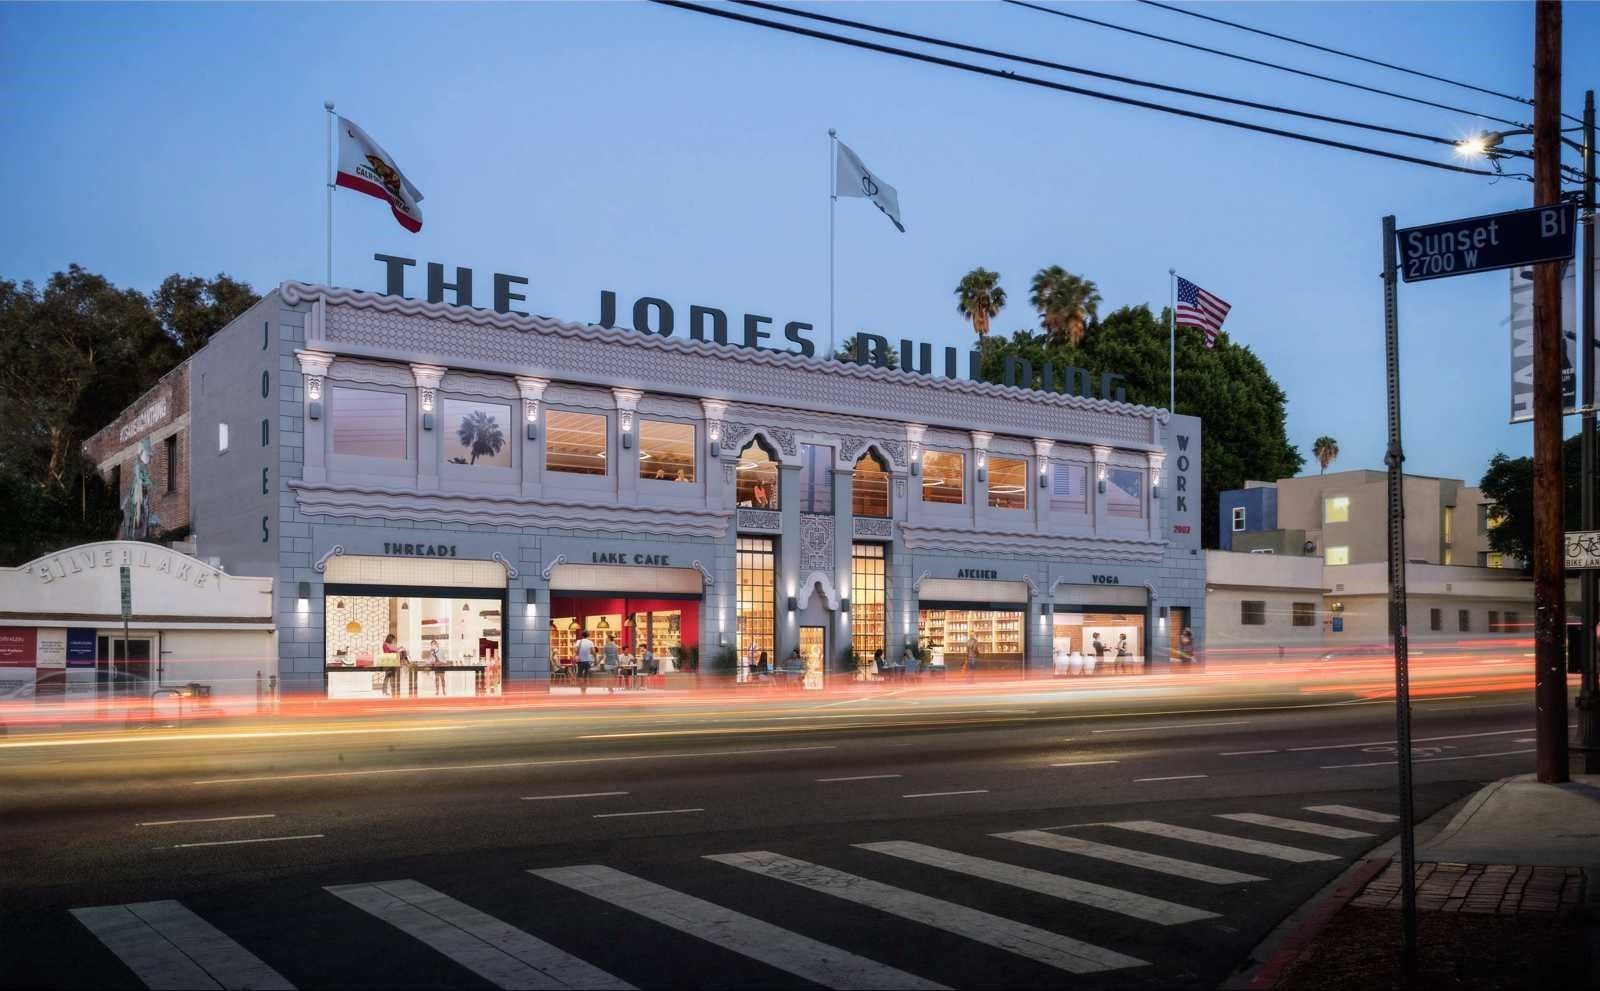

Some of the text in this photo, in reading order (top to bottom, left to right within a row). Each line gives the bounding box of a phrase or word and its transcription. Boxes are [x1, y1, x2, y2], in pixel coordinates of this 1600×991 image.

[1407, 208, 1566, 257] Sunset Bl
[1409, 250, 1478, 277] 2700 W
[374, 253, 1127, 401] THE JONES BUILDING
[261, 321, 270, 543] JONES
[1176, 435, 1190, 512] WORK
[383, 542, 457, 557] THREADS
[592, 551, 670, 566] LAKE CAFE
[957, 568, 997, 579] ATELIER
[1565, 559, 1583, 567] BIKE
[1091, 574, 1119, 584] YOGA
